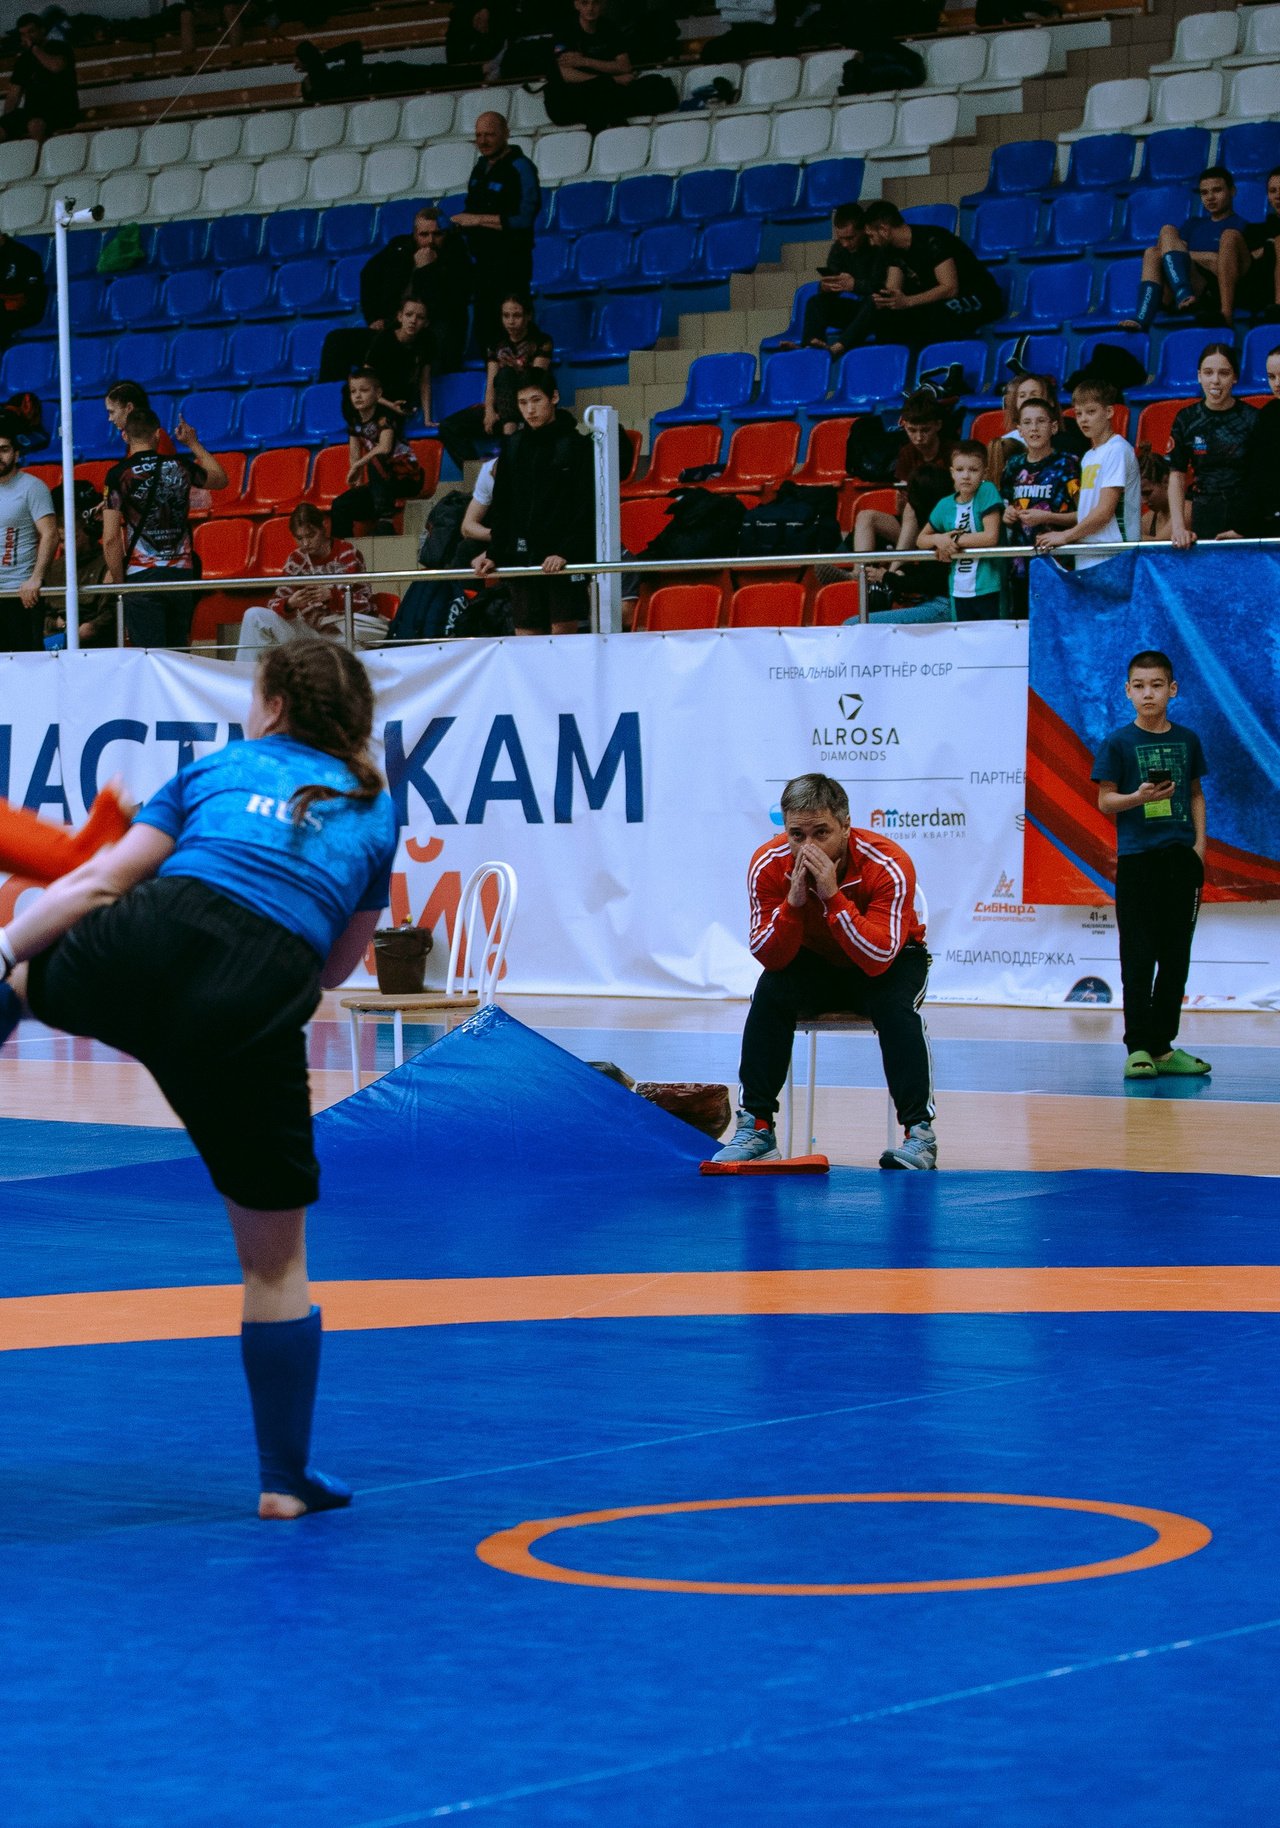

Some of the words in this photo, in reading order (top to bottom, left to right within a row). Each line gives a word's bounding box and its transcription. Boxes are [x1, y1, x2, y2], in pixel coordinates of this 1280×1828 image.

[768, 662, 847, 680] ГЕНЕРАЛЬНЫЙ
[850, 661, 918, 678] ПАРТНЁР
[920, 662, 953, 677] ФСБР
[812, 727, 901, 746] ALROSA
[820, 750, 888, 762] DIAMONDS
[970, 769, 1027, 785] ПАРТНЁ
[870, 807, 967, 829] amsterdam
[877, 831, 918, 840] РГОВЫЙ
[974, 902, 1037, 916] СибНорд
[946, 950, 1076, 967] МЕДИАПОДДЕРЖКА
